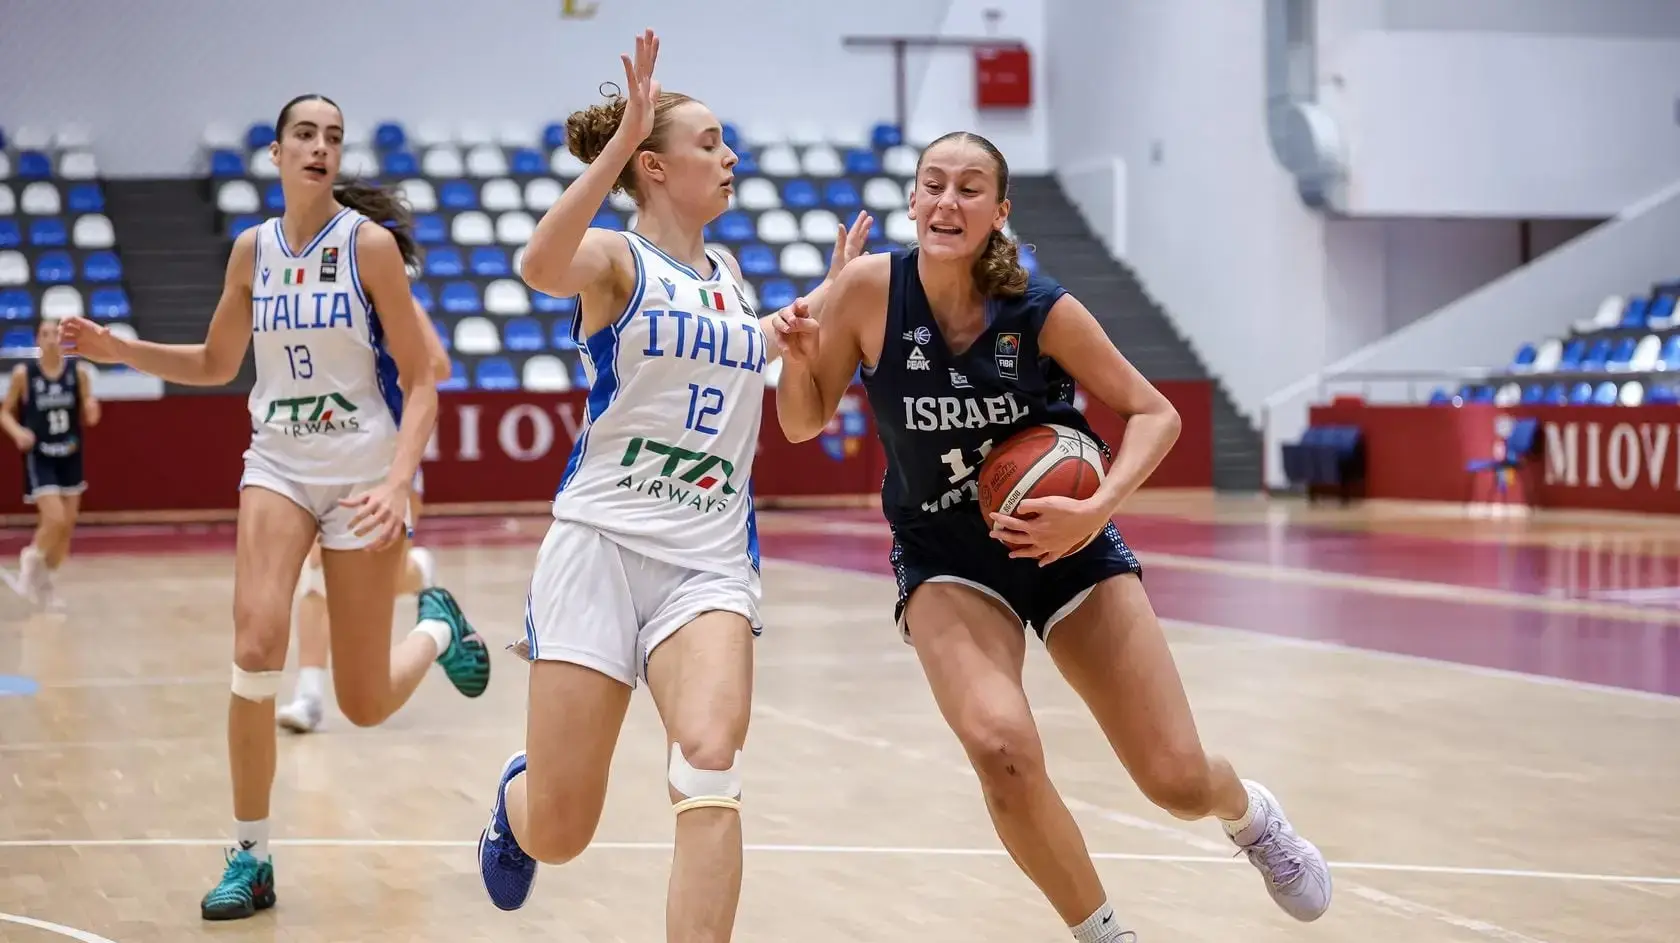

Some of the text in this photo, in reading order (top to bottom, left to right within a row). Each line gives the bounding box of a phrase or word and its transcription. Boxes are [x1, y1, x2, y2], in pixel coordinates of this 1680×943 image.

[253, 292, 352, 332] ITALIA
[284, 344, 313, 380] 13
[907, 359, 931, 371] PEAK
[999, 359, 1014, 369] FIBA
[264, 392, 358, 423] ITA
[685, 383, 725, 436] 12
[903, 392, 1029, 431] ISRAEL
[620, 437, 737, 495] ITA
[1544, 421, 1680, 491] MIOV
[616, 474, 729, 513] AIRWAYS
